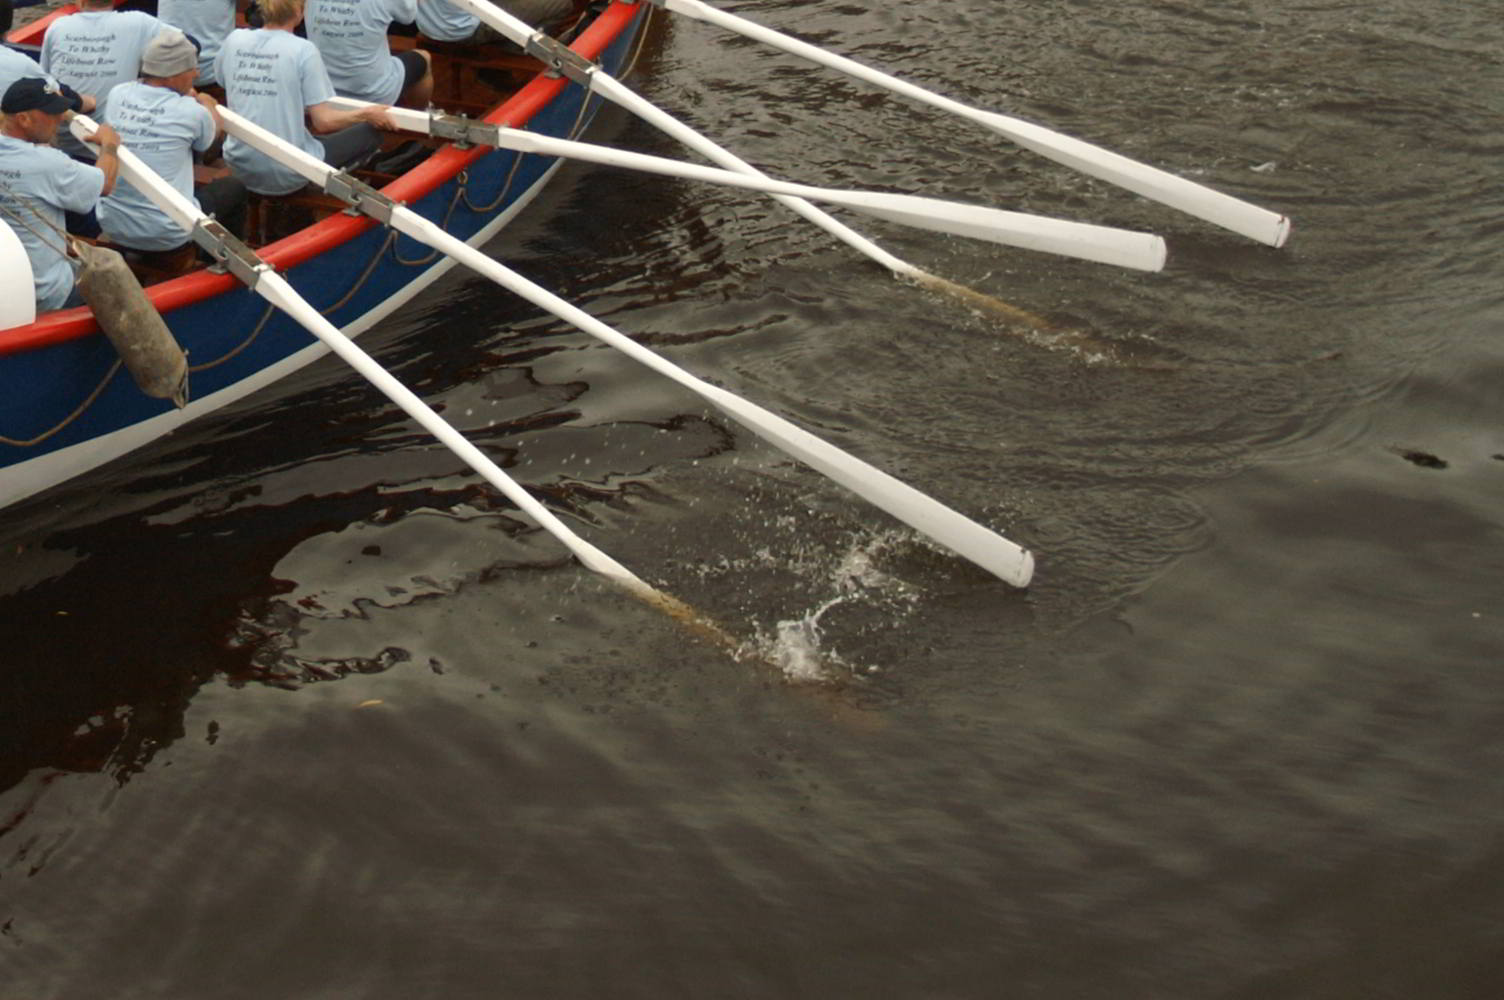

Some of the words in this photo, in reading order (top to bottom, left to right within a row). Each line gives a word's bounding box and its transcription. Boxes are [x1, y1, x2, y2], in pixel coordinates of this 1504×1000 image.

[64, 33, 116, 43] Scarborough
[68, 44, 79, 52] To
[81, 45, 110, 54] Whitby
[96, 56, 116, 65] Row
